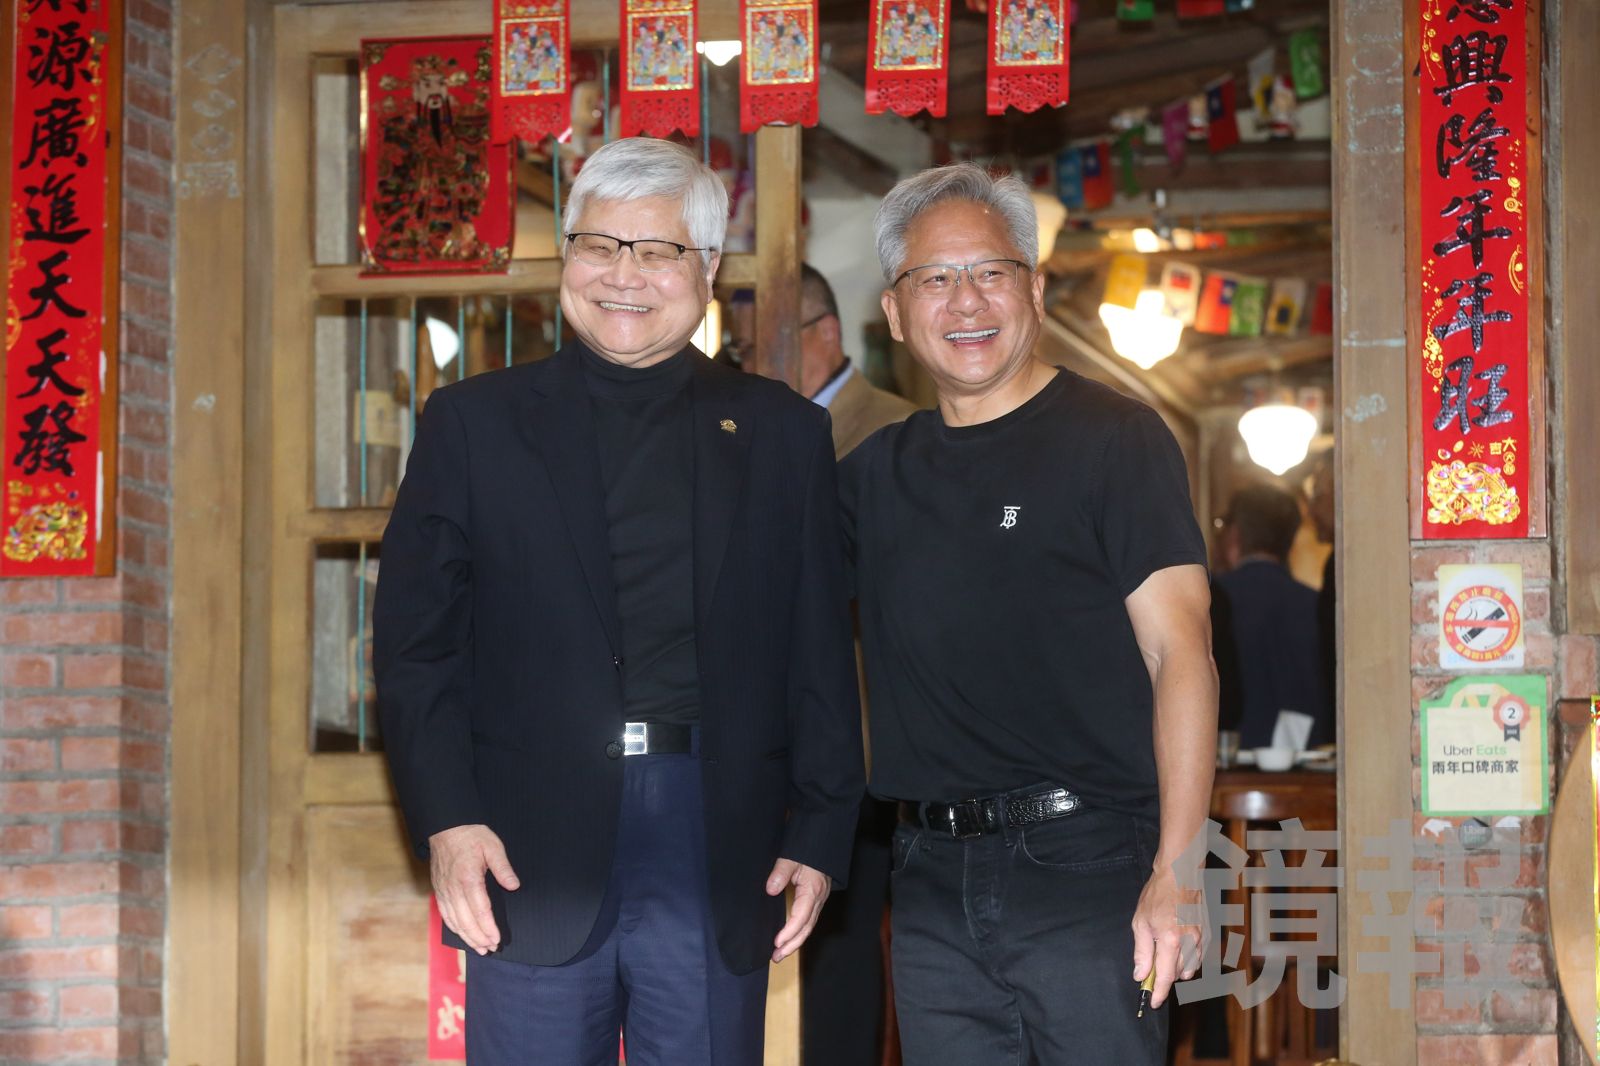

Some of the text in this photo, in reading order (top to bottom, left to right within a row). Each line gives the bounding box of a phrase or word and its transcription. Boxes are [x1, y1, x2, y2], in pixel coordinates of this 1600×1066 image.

[14, 0, 94, 478] 源廣進天天發
[1508, 707, 1516, 719] 2
[1443, 744, 1507, 756] Uber Eats
[1432, 760, 1519, 776] 兩年口碑商家
